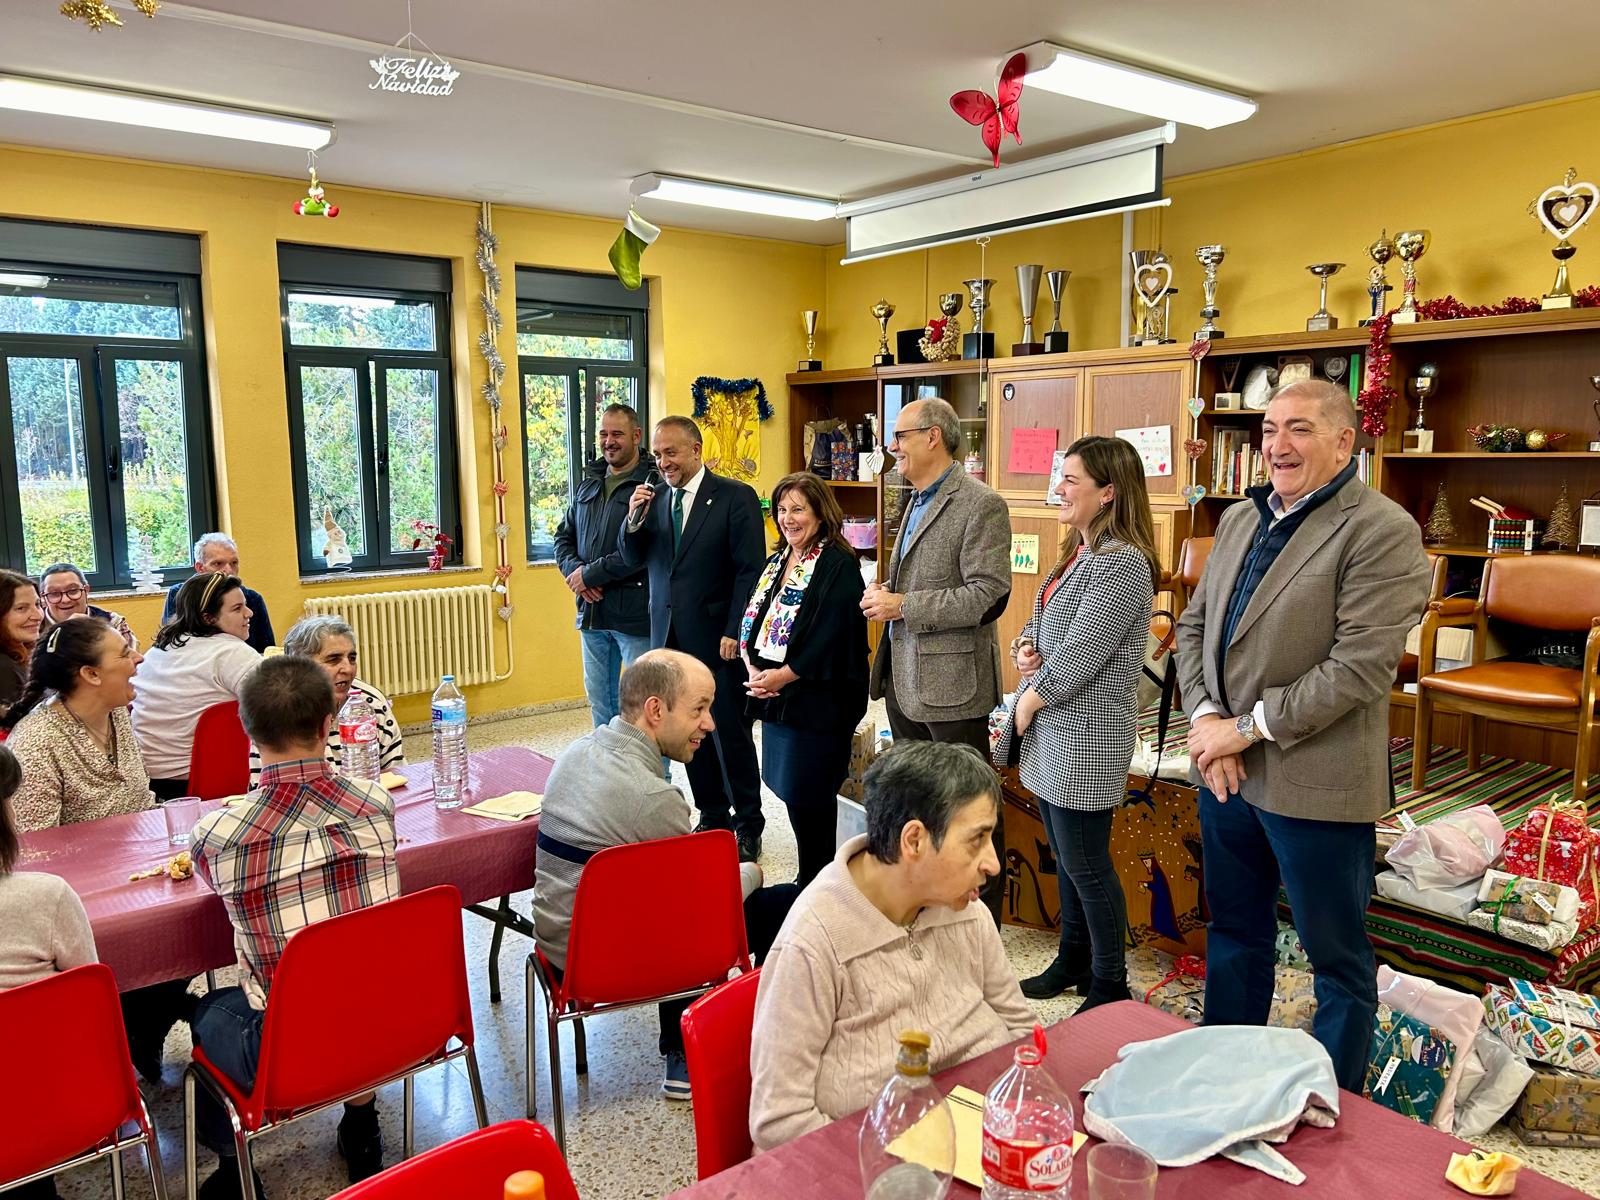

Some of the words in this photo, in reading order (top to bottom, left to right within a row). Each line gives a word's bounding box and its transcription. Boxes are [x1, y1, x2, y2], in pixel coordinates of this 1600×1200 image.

[386, 57, 443, 79] Feliz
[368, 74, 454, 95] Navidad
[1030, 1154, 1073, 1178] SOLARE
